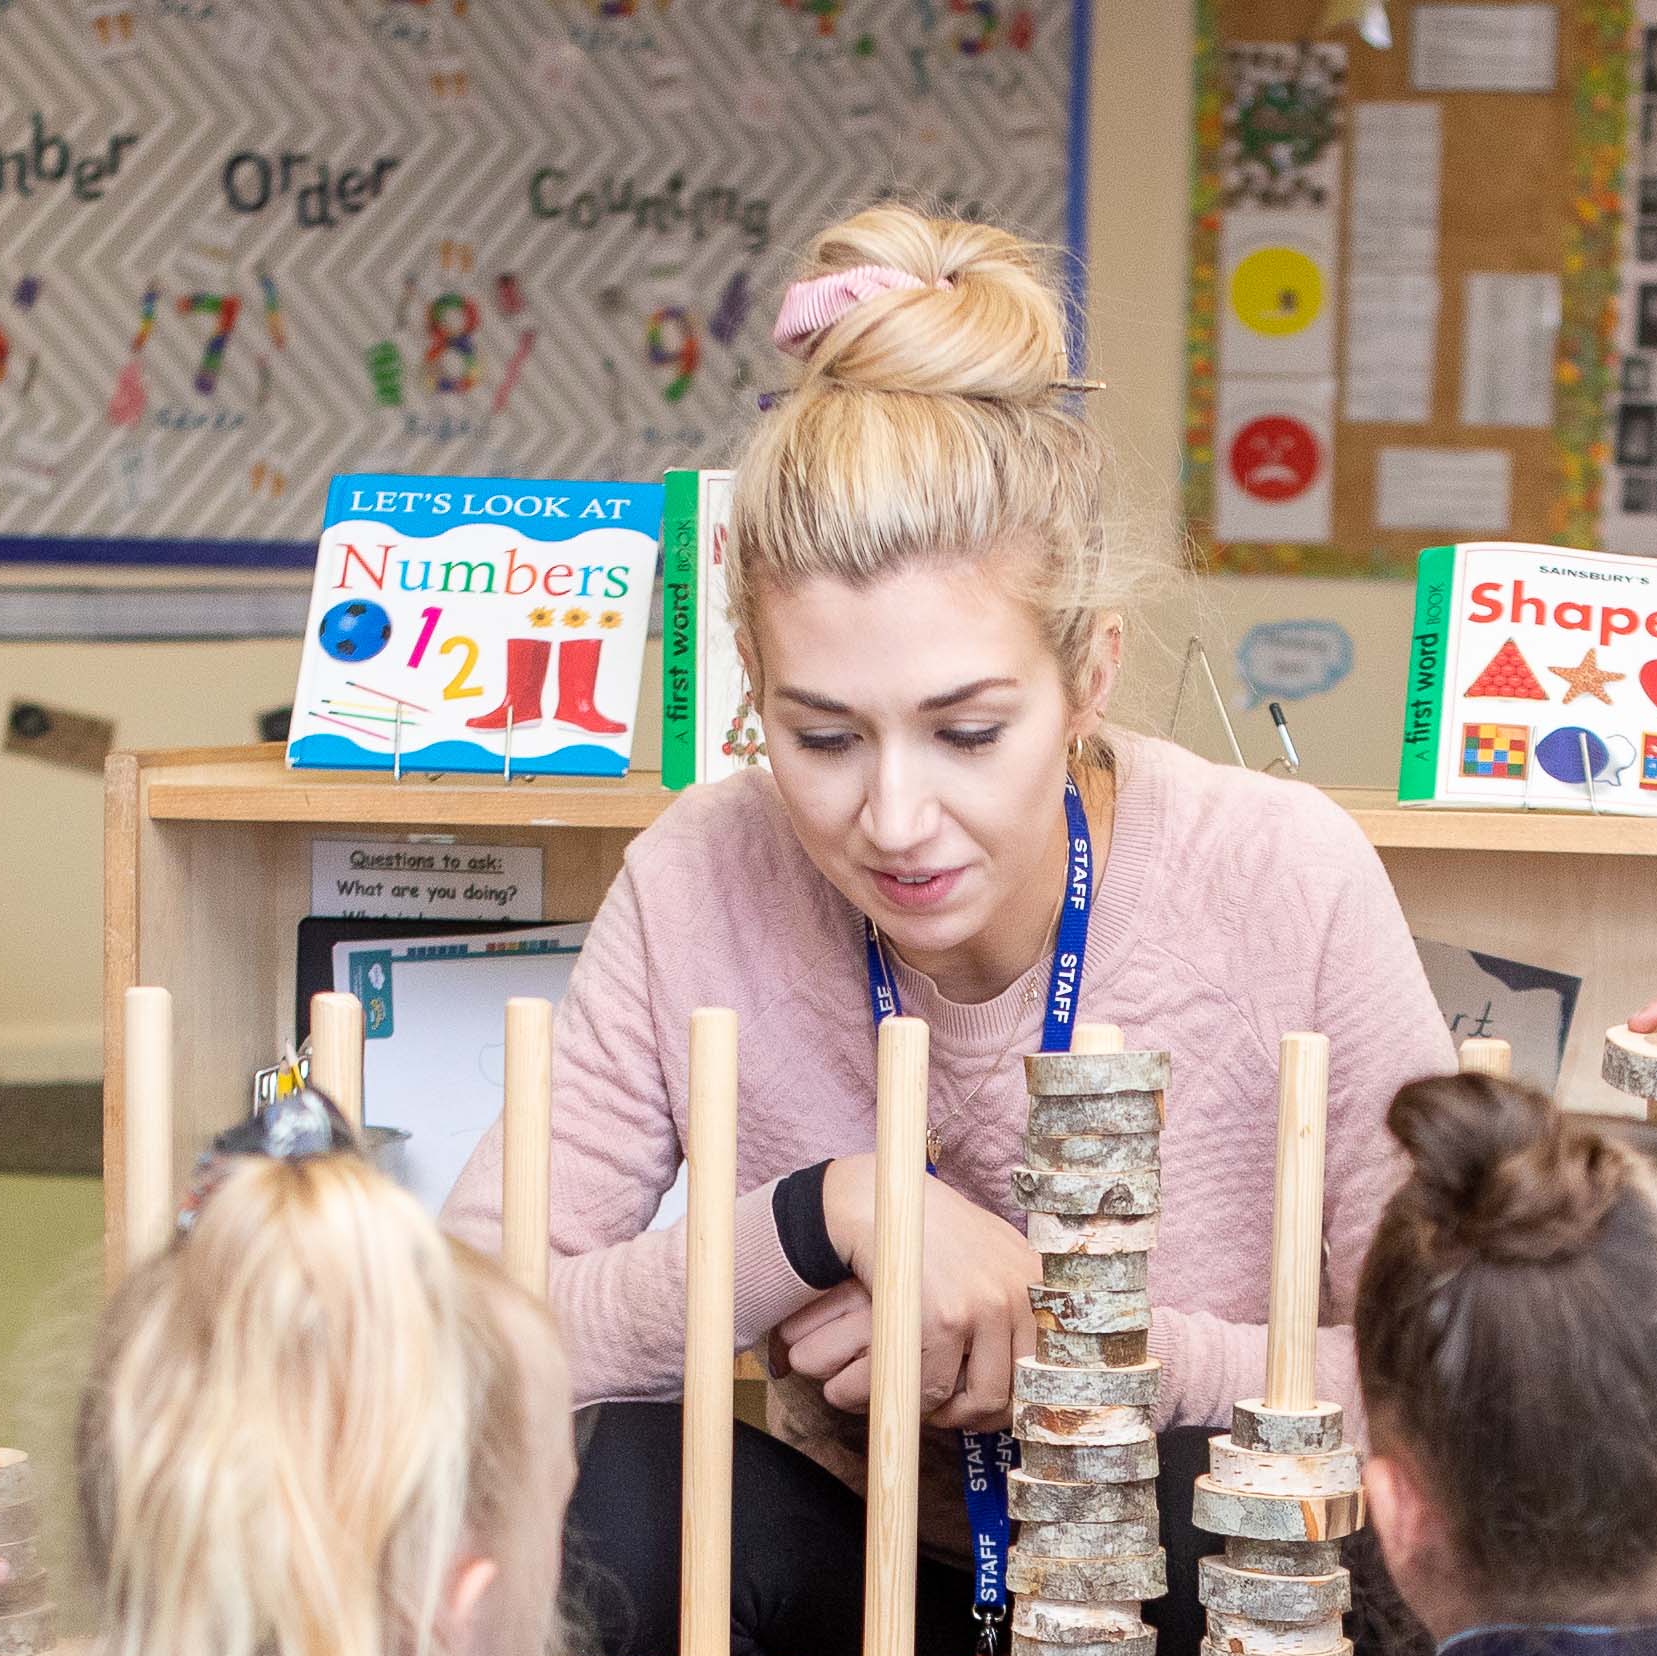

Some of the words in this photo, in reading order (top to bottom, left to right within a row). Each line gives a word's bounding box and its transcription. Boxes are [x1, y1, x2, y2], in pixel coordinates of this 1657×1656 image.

[223, 151, 401, 228] Order
[530, 166, 771, 254] Counting
[174, 291, 244, 396] 7
[425, 291, 482, 396] 8
[644, 305, 701, 404] 9
[349, 490, 452, 515] LET'S
[461, 493, 571, 519] LOOK
[579, 498, 631, 521] AT
[331, 542, 631, 599] Numbers
[677, 519, 691, 573] BOOK
[1538, 564, 1651, 586] SAINSBURY'S
[667, 582, 690, 657] word
[1426, 584, 1443, 626] BOOK
[407, 606, 443, 669] 1
[1415, 632, 1439, 693] word
[438, 635, 484, 701] 2
[666, 665, 689, 722] first
[675, 730, 689, 744] A
[1405, 699, 1434, 745] first
[1415, 750, 1431, 762] A
[349, 849, 435, 870] Questions
[443, 853, 461, 870] to
[467, 855, 503, 871] ask:
[1070, 838, 1088, 911] STAFF
[336, 879, 383, 897] What
[391, 885, 419, 898] are
[427, 886, 457, 903] you
[462, 884, 518, 906] doing?
[1052, 953, 1078, 1025] STAFF
[994, 1431, 1014, 1473] AFF
[979, 1533, 998, 1602] STAFF
